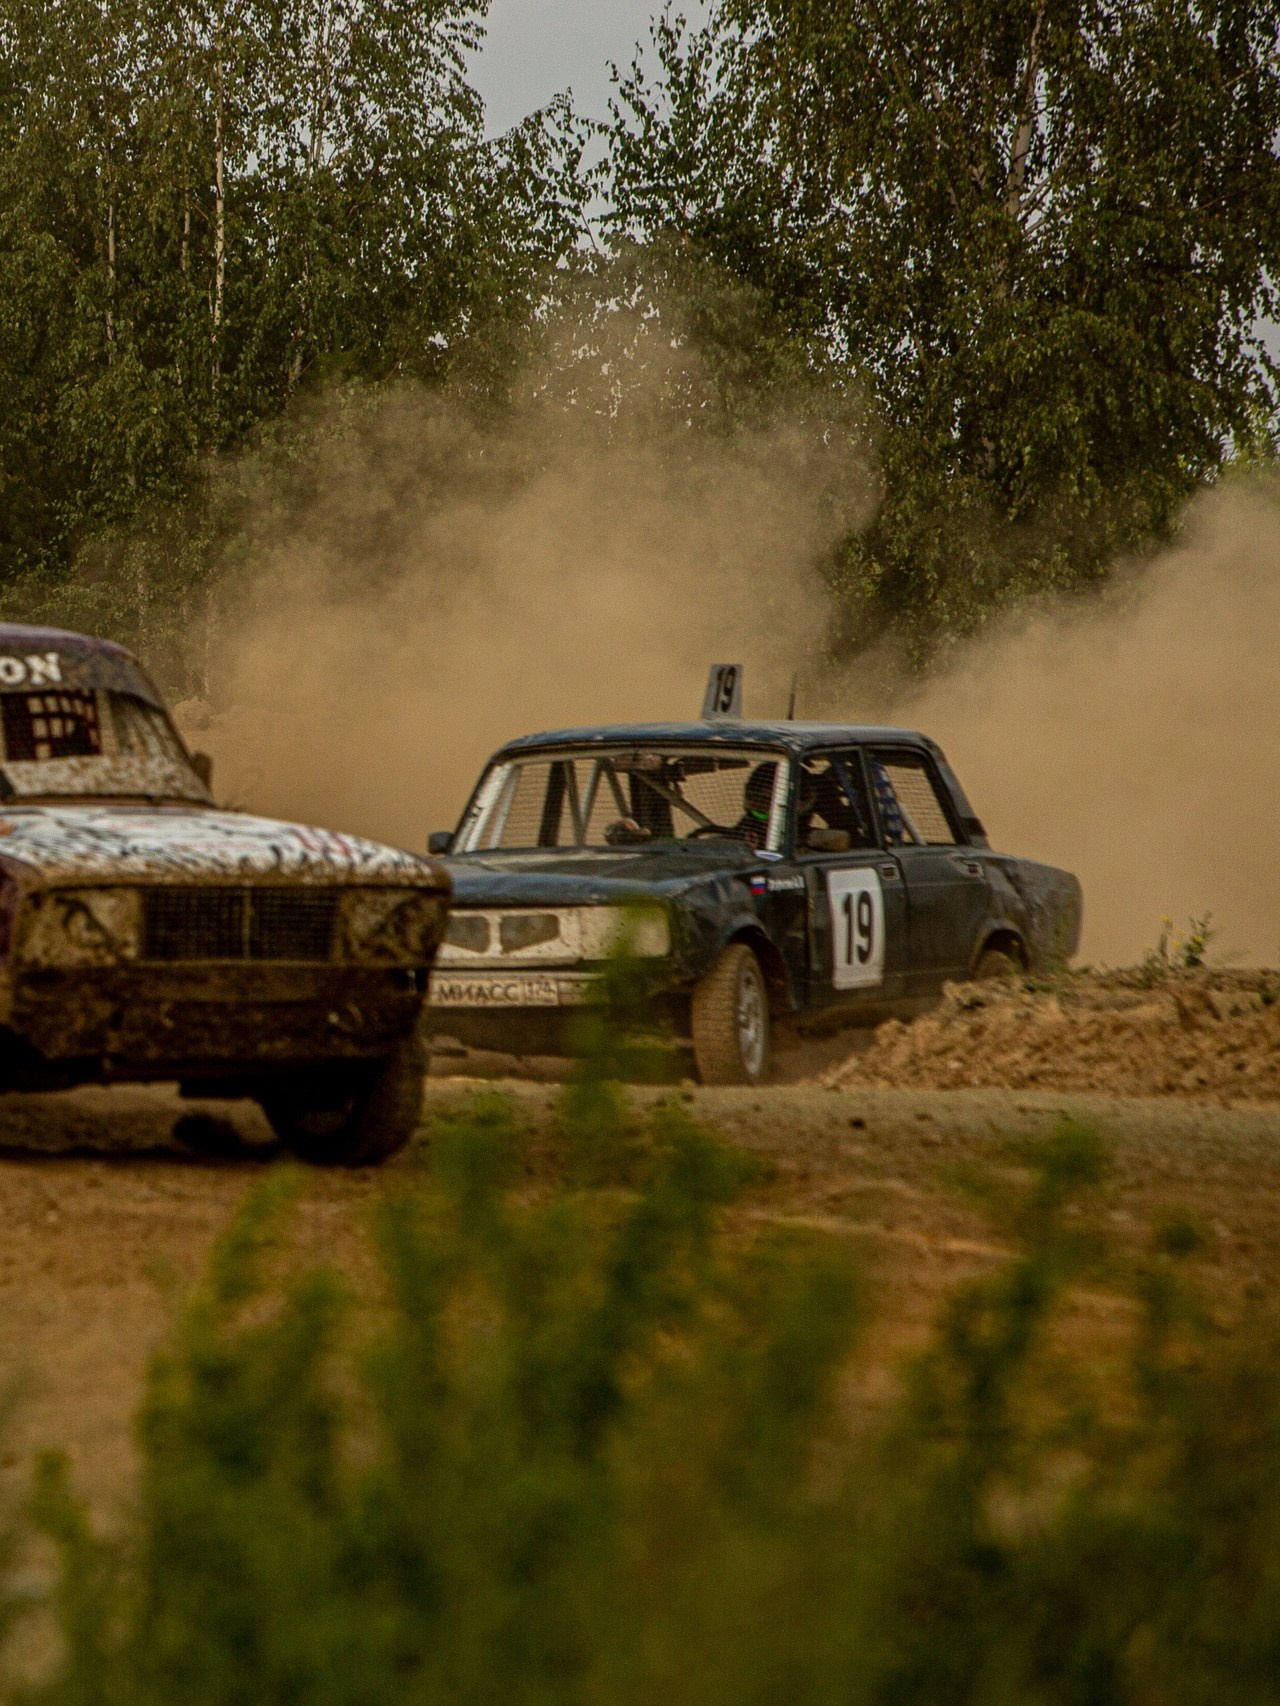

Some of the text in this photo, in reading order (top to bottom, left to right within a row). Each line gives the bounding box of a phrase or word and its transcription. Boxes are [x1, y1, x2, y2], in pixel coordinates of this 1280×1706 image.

[712, 666, 737, 713] 19
[843, 890, 874, 966] 19
[439, 983, 518, 1001] МИАСС
